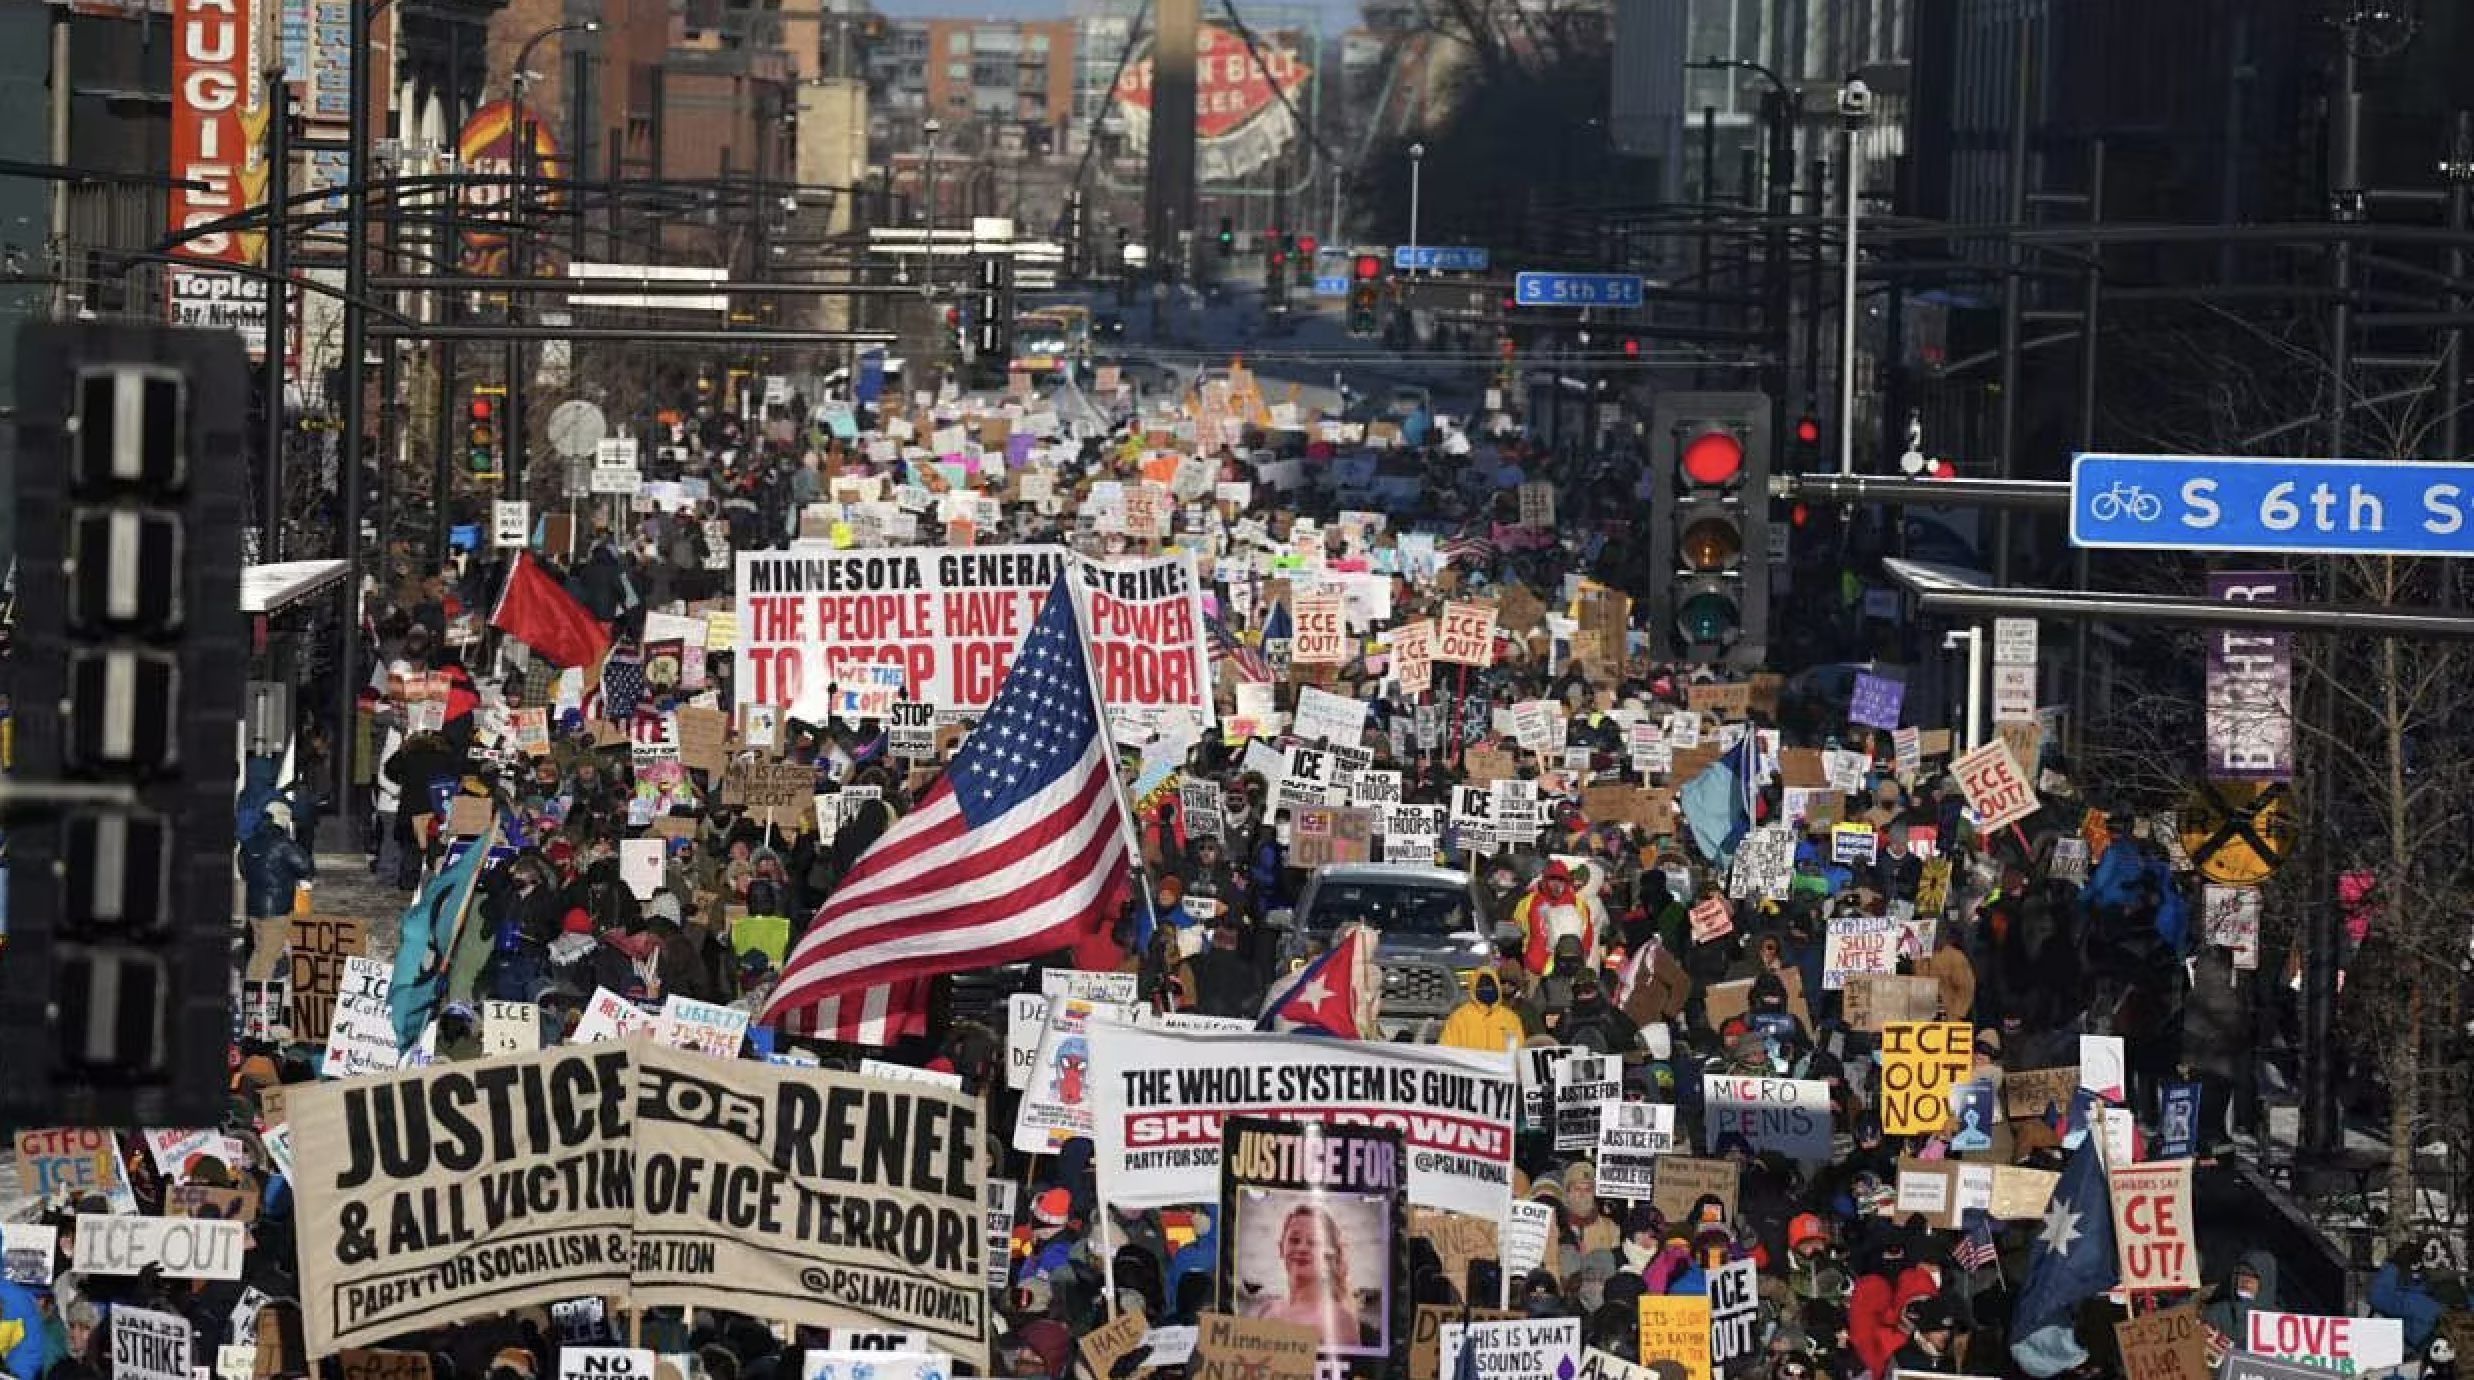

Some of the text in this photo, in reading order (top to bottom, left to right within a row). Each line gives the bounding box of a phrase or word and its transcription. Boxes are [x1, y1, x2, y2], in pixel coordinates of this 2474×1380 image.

[1527, 279, 1635, 300] S 5th St
[2182, 478, 2220, 528] S
[2260, 480, 2385, 532] 6th
[749, 557, 922, 592] MINNESOTA
[1082, 562, 1187, 601] STRIKE:
[747, 596, 804, 643] THE
[818, 593, 932, 641] PEOPLE
[943, 591, 1017, 637] HAVE
[1092, 591, 1193, 646] POWER
[1295, 613, 1335, 633] ICE
[1447, 614, 1487, 641] ICE
[1295, 636, 1338, 654] OUT!
[1395, 639, 1428, 663] ICE
[1443, 637, 1488, 660] OUT!
[871, 666, 903, 686] THE
[892, 703, 934, 727] STOP
[1291, 750, 1324, 780] ICE
[1965, 761, 2013, 799] ICE
[1396, 807, 1421, 817] NO
[1461, 788, 1492, 819] ICE
[1979, 782, 2026, 820] OUT!
[1388, 816, 1431, 835] TROOPS
[290, 919, 358, 957] ICE
[358, 974, 389, 1000] IC
[491, 1002, 530, 1022] ICE
[1883, 1025, 1971, 1054] ICE
[1884, 1061, 1968, 1091] OUT
[1123, 1065, 1515, 1120] THE WHOLE SYSTEM IS GUILTY!
[1557, 1080, 1619, 1103] JUSTICE FOR
[1713, 1080, 1798, 1102] MICRO
[336, 1052, 632, 1189] JUSTICE
[772, 1081, 977, 1201] RENEE
[1718, 1106, 1814, 1138] PENIS
[21, 1128, 101, 1156] GTFO
[1603, 1130, 1670, 1149] JUSTICE FOR
[1125, 1150, 1164, 1171] PARTY
[1165, 1149, 1192, 1168] FOR
[1231, 1131, 1396, 1187] JUSTICE FOR
[336, 1199, 379, 1267] &
[389, 1183, 475, 1255] ALL
[644, 1153, 705, 1215] OF
[707, 1161, 789, 1233] ICE
[794, 1184, 980, 1275] TERROR!
[2125, 1194, 2177, 1237] CE
[81, 1221, 239, 1272] ICE OUT
[477, 1233, 603, 1286] SOCIALISM
[2129, 1242, 2184, 1282] UT!
[115, 1316, 186, 1338] JAN.23
[1091, 1317, 1139, 1355] HATE
[1474, 1325, 1575, 1350] HIS IS WHAT
[1711, 1315, 1753, 1361] OUT
[2251, 1311, 2351, 1357] LOVE
[116, 1329, 186, 1377] STRIKE
[585, 1355, 633, 1374] NO
[1477, 1350, 1543, 1372] SOUNDS
